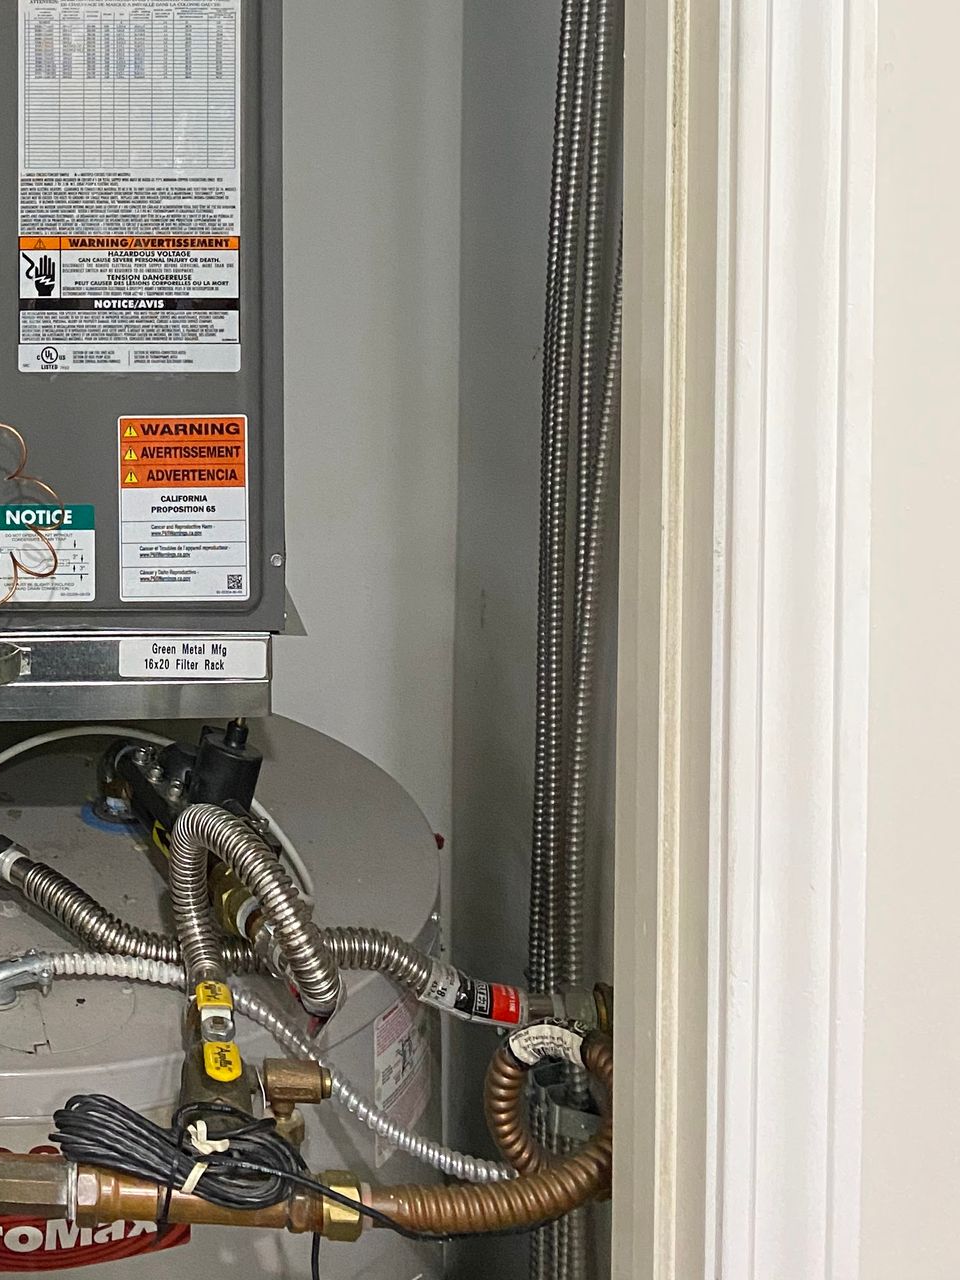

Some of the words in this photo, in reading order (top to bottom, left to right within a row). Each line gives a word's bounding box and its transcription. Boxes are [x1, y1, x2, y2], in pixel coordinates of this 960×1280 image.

[69, 239, 230, 248] WARNING/AVERTISSEMENT
[94, 300, 164, 308] NOTICE/AVIS
[141, 423, 240, 436] WARNING
[141, 446, 241, 458] AVERTISSEMENT
[147, 469, 238, 481] ADVERTENCIA
[6, 510, 72, 525] NOTICE
[152, 643, 176, 654] Green
[182, 644, 205, 654] Metal
[212, 644, 227, 657] Mfg
[145, 659, 169, 670] 16x20
[176, 659, 198, 670] Filter
[205, 659, 224, 670] Rack
